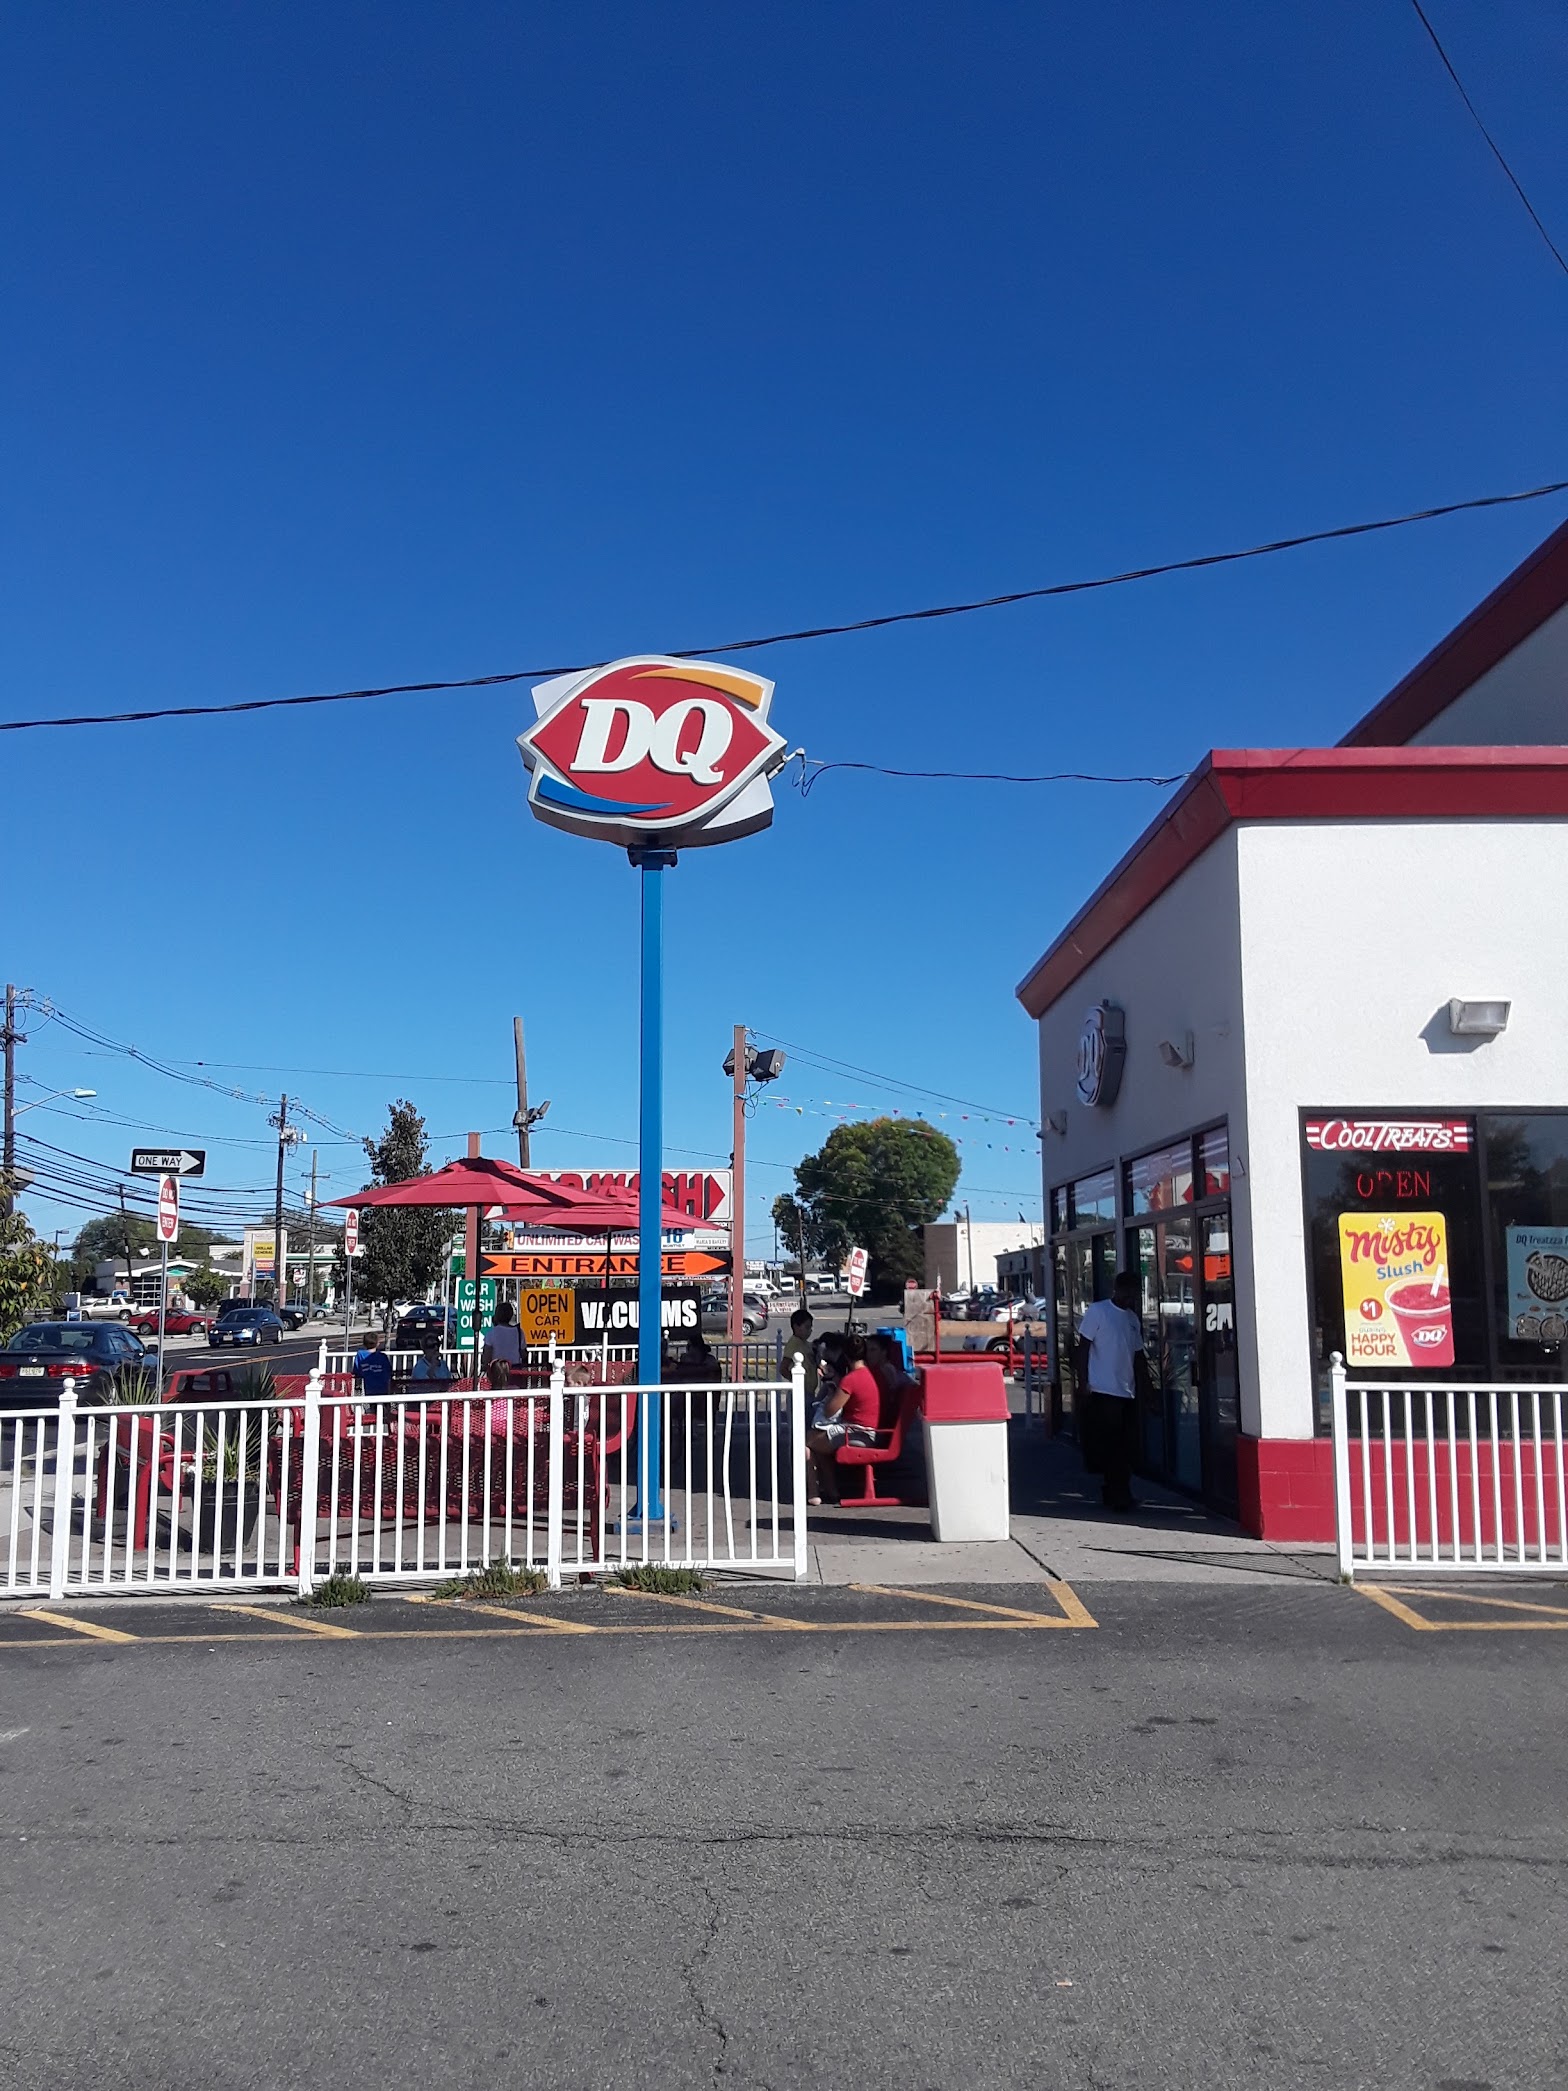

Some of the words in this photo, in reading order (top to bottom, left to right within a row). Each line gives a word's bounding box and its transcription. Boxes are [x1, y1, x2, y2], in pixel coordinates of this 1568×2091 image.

[569, 698, 734, 786] DQ
[138, 1156, 158, 1166] ONE
[161, 1156, 183, 1167] WAY
[517, 1234, 583, 1247] UNLIMITED
[511, 1257, 686, 1272] ENTRANE
[1376, 1260, 1424, 1280] Slush
[527, 1293, 568, 1313] OPEN
[1362, 1301, 1377, 1318] $1
[535, 1315, 560, 1326] CAR
[580, 1299, 698, 1329] VACUMS
[1351, 1333, 1396, 1344] HAPPY
[1417, 1328, 1443, 1343] DQ
[1352, 1344, 1398, 1356] HOUR
